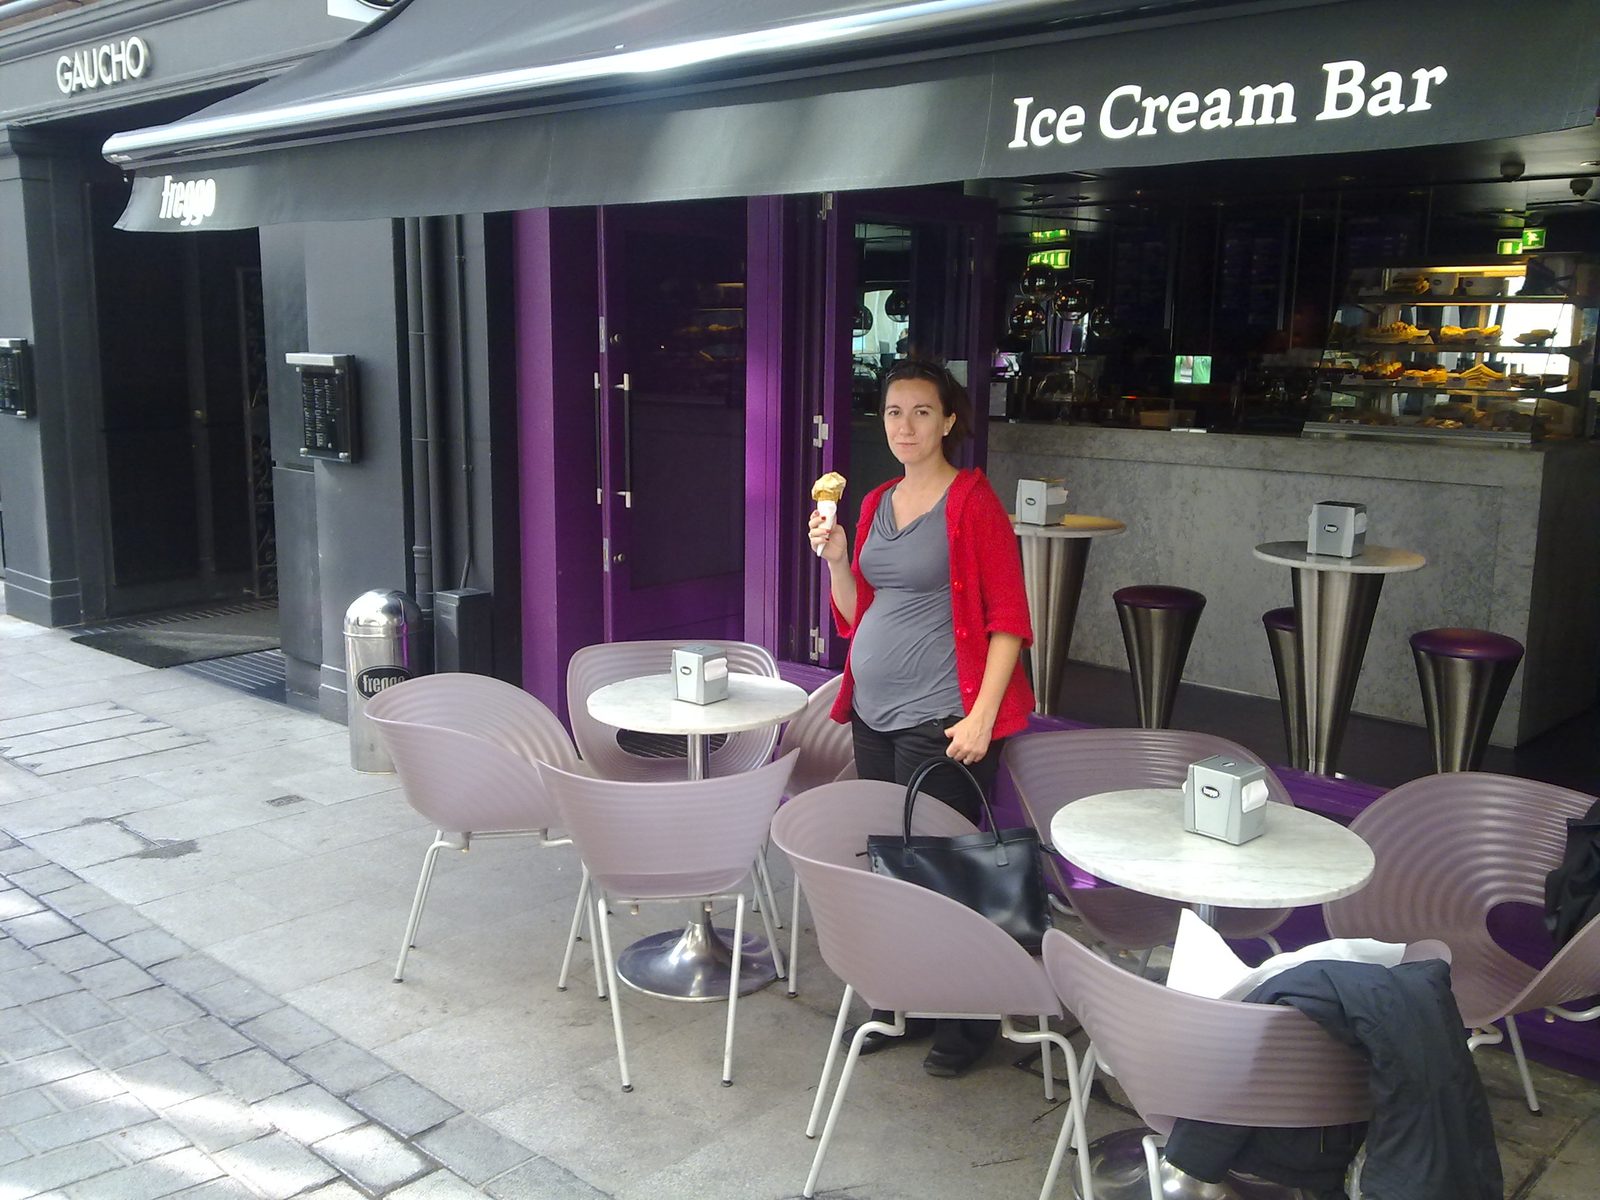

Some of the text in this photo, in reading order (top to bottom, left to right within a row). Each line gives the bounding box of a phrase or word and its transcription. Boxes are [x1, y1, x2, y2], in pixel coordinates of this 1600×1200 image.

[56, 36, 149, 94] GAUCHO
[1008, 60, 1448, 149] Ice Cream Bar
[362, 674, 406, 693] freg
